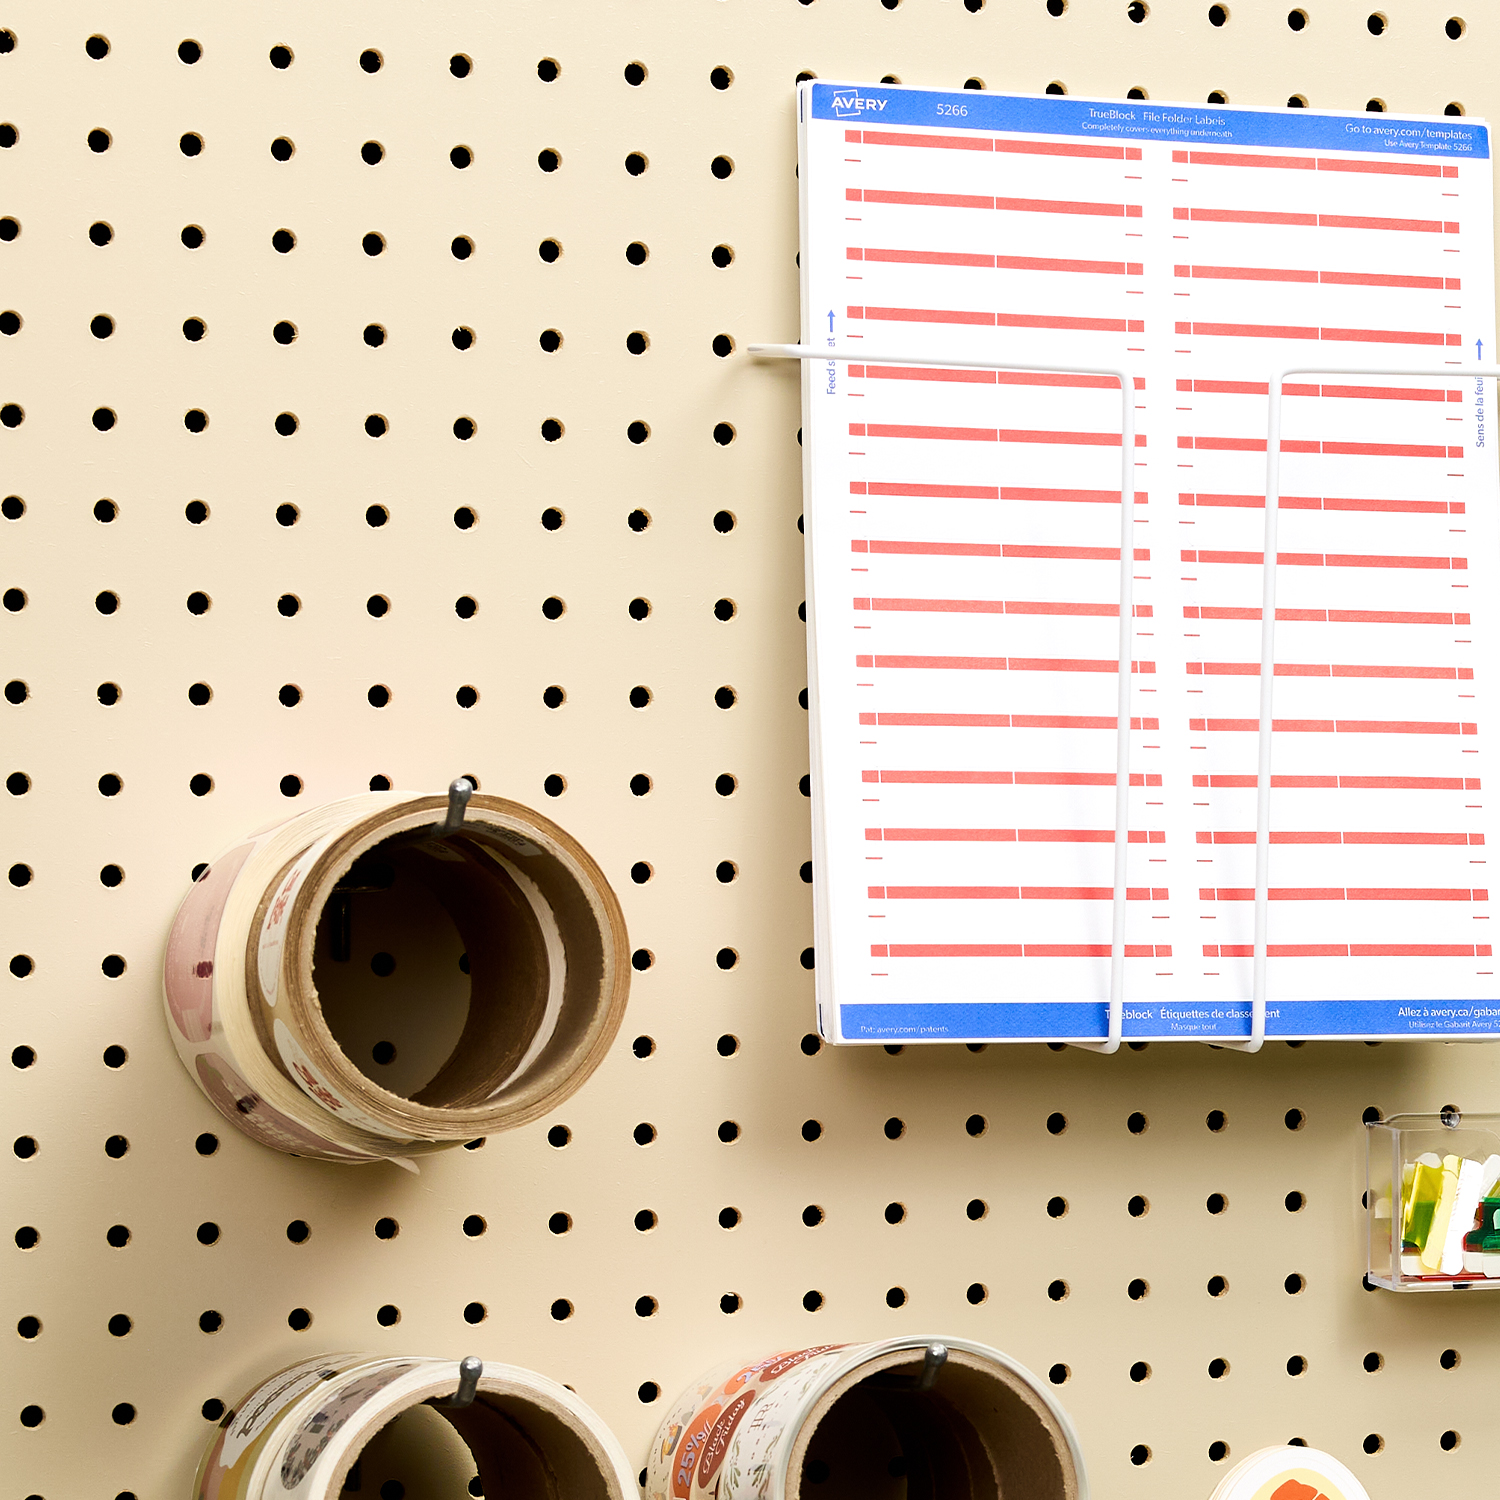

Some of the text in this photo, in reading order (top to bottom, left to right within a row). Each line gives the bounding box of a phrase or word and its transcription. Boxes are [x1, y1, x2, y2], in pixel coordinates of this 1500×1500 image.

[831, 94, 888, 112] AVERY
[936, 103, 969, 117] 5266
[1088, 108, 1226, 126] TrueBlock File Folder Labels
[1081, 121, 1233, 138] Completely covers everything underneath
[1345, 123, 1473, 141] Go to avery.com/templates
[1384, 139, 1473, 152] Use Avery Template 5266
[826, 337, 836, 395] Feed set
[1475, 397, 1484, 406] la
[1475, 408, 1484, 422] de
[1476, 423, 1485, 448] Sens
[1104, 1006, 1281, 1020] Teblock Étiquettes de classeent
[1398, 1007, 1422, 1017] Allez
[1422, 1007, 1430, 1016] à
[877, 1025, 949, 1035] avery.com/patents
[1170, 1023, 1217, 1031] Masque tout
[1408, 1020, 1434, 1029] Utilisez
[1435, 1020, 1443, 1028] le
[1444, 1020, 1471, 1028] Gabarit
[1472, 1020, 1493, 1030] Avery
[715, 1399, 745, 1455] Friday
[677, 1431, 705, 1488] 25%
[700, 1419, 713, 1444] off
[701, 1419, 726, 1475] Black
